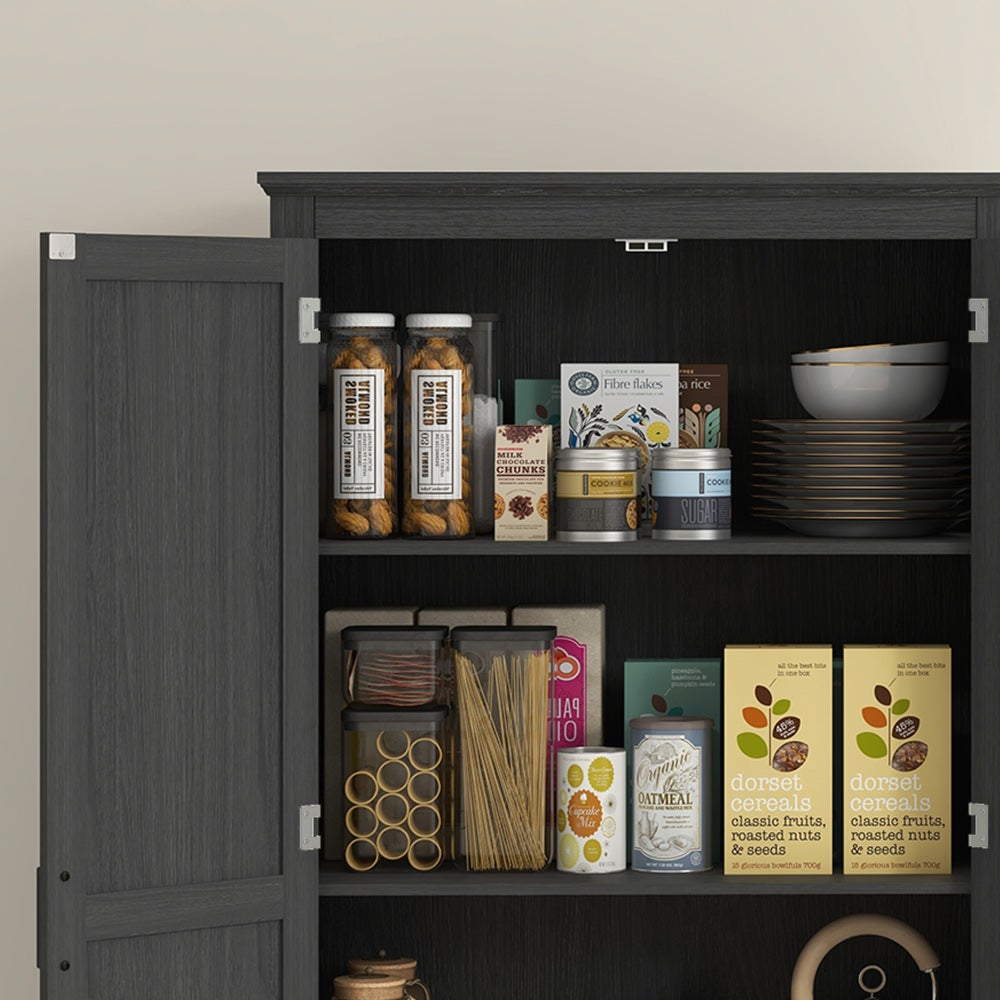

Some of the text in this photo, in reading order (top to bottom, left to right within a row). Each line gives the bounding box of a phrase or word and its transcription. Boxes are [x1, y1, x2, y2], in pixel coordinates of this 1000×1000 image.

[604, 378, 663, 389] Fibre flakes
[691, 378, 711, 389] rice
[680, 499, 717, 525] SUGAR
[637, 749, 690, 791] Organic
[731, 774, 802, 791] dorset
[850, 774, 922, 791] dorset
[639, 792, 693, 805] OATMEAL
[731, 794, 811, 812] cereals
[850, 793, 930, 811] cereals
[569, 805, 600, 818] Cupcake
[580, 816, 596, 828] Mix
[731, 815, 826, 827] classic fruits,
[851, 815, 945, 827] classic fruits,
[731, 830, 821, 841] roasted nuts
[851, 830, 941, 840] roasted nuts
[731, 844, 786, 855] & seeds
[851, 844, 905, 855] & seeds
